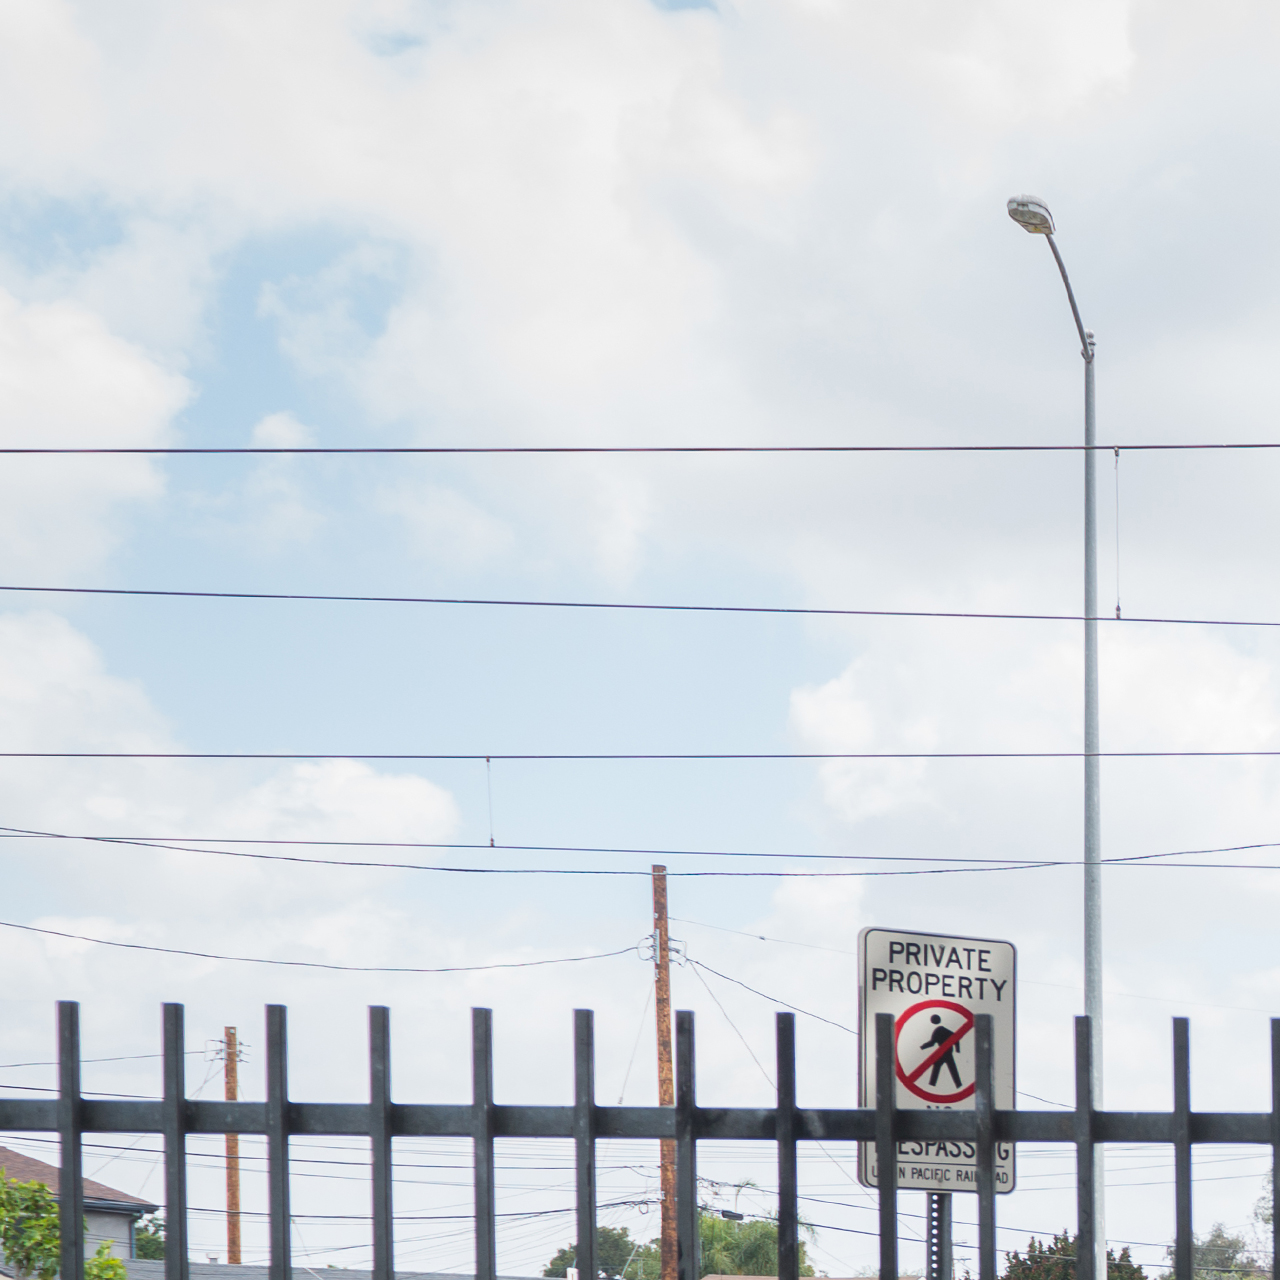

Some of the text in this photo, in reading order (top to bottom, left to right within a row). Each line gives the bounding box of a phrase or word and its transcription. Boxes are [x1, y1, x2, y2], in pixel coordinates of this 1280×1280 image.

[889, 941, 992, 972] PRIVATE
[872, 968, 1007, 1001] PROPERTY
[874, 1141, 1010, 1161] ESPASSG
[911, 1167, 951, 1181] PACIFIC
[956, 1169, 1009, 1184] RAIAD
